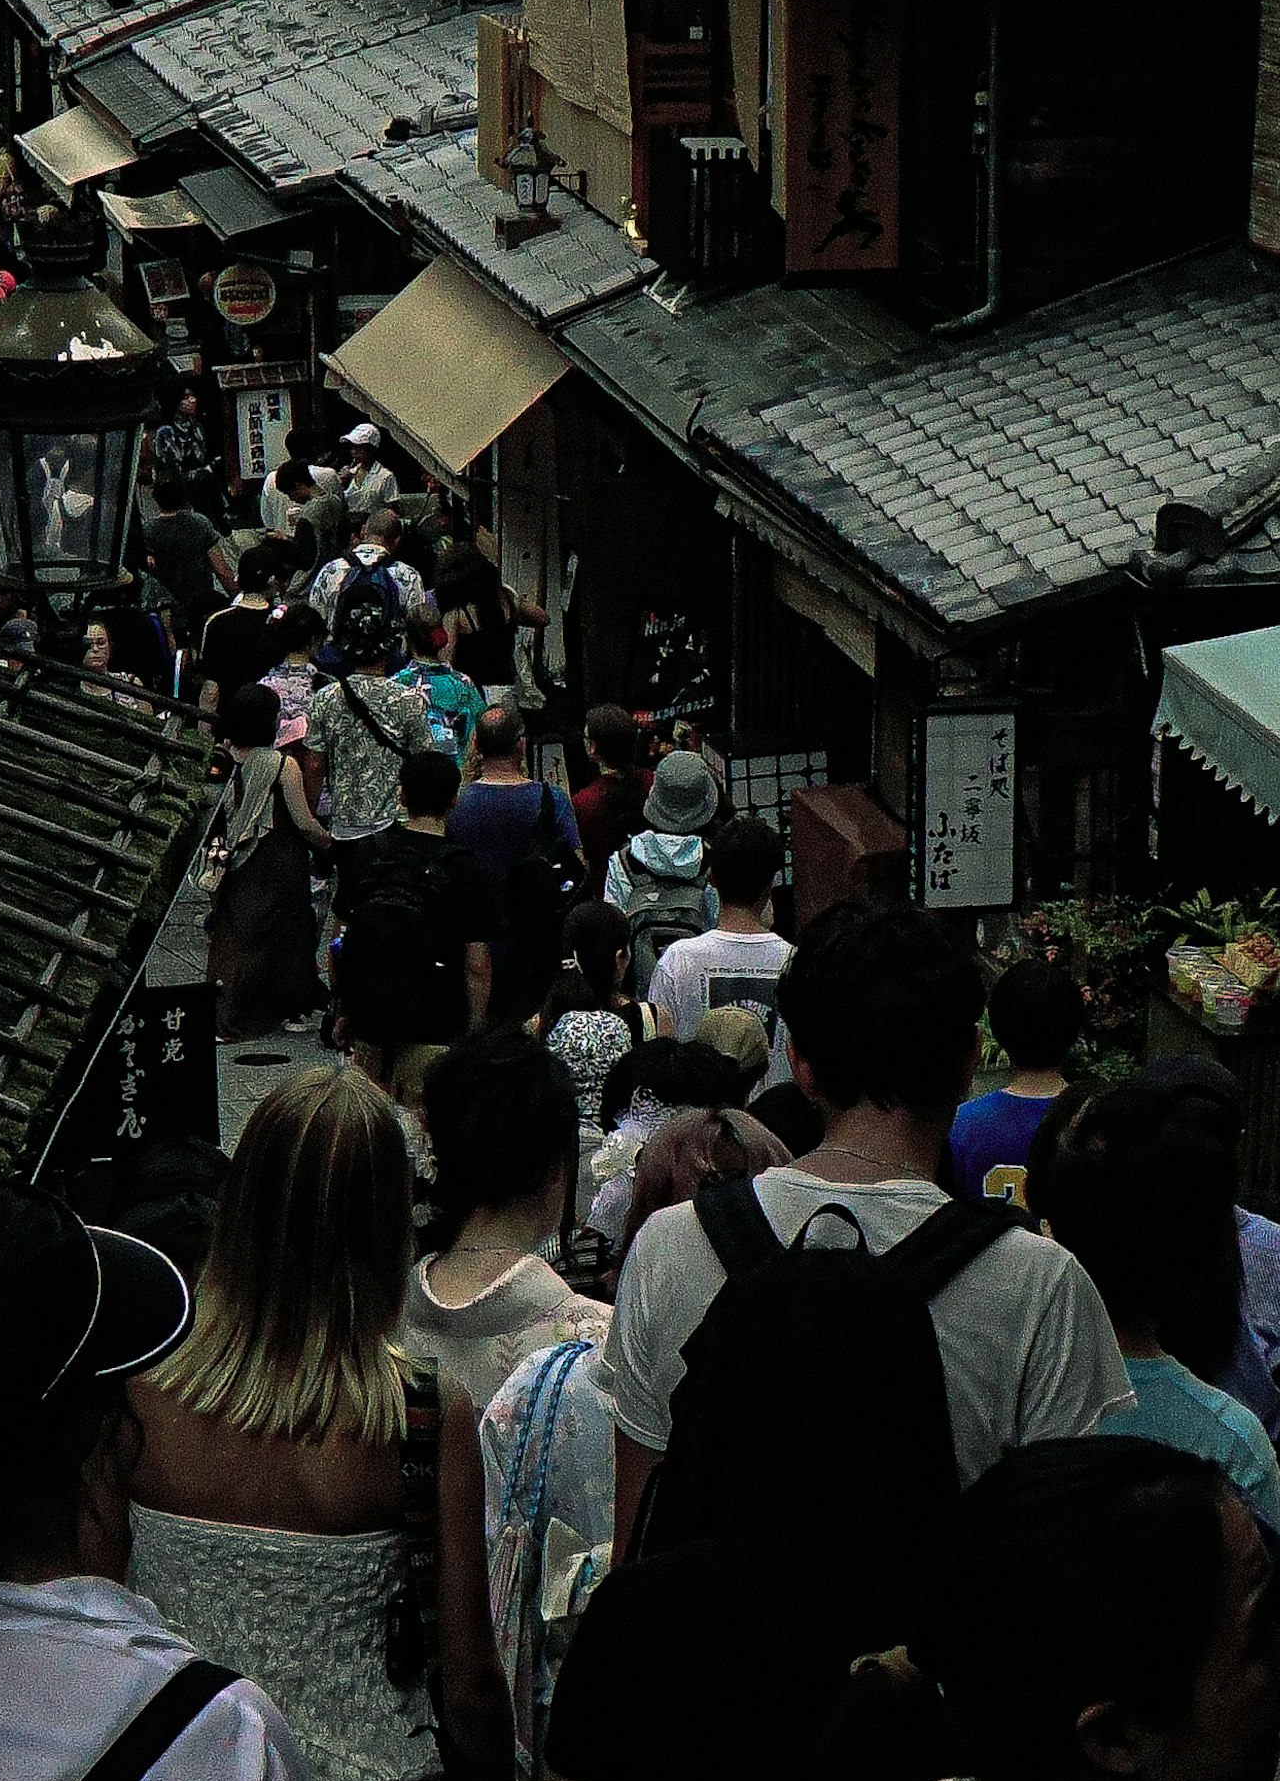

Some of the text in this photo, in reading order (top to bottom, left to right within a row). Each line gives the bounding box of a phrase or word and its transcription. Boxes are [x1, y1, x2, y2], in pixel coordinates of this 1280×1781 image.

[989, 728, 1010, 799] そば処
[929, 811, 958, 891] ふたば
[161, 1006, 186, 1066] 甘党
